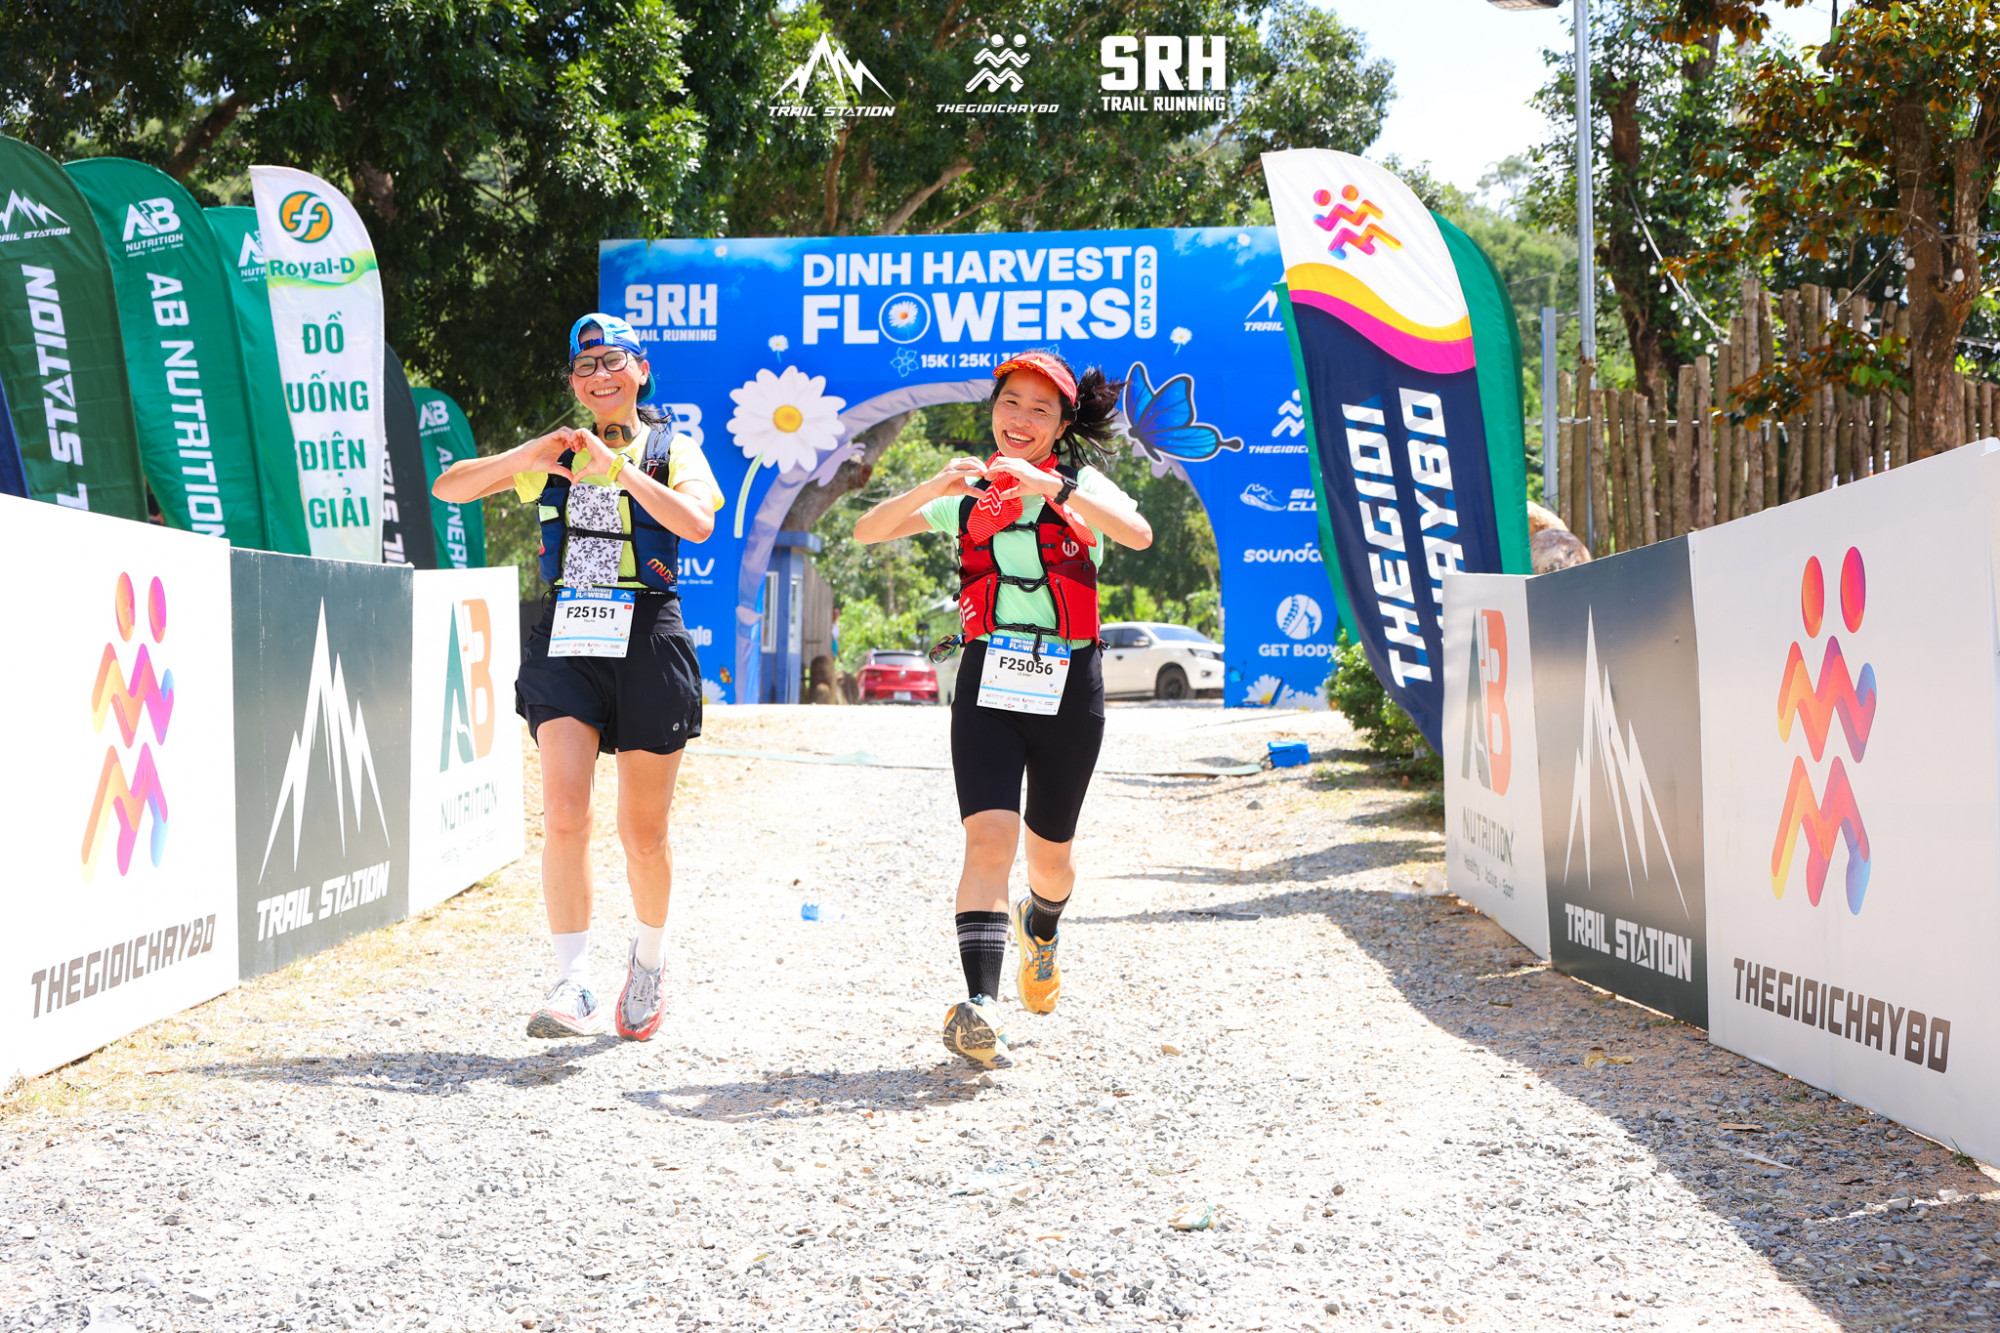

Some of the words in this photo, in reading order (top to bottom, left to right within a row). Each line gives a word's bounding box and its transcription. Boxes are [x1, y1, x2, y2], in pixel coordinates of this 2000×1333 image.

[0, 233, 20, 242] AIL
[24, 227, 71, 240] STATION
[122, 197, 181, 242] AB
[125, 233, 184, 252] NUTRITION
[269, 257, 355, 278] Royal-D
[803, 252, 912, 287] DINH
[923, 246, 1133, 285] HARVEST
[146, 272, 190, 327] AB
[625, 284, 718, 327] SRH
[1140, 254, 1152, 331] 2025
[301, 311, 345, 355] ĐỒ
[634, 329, 660, 342] RAIL
[663, 328, 717, 342] RUNNING
[803, 287, 1132, 345] FLOWERS
[1244, 321, 1284, 332] TRAIL
[21, 264, 83, 466] STATION
[921, 354, 949, 368] 15K
[959, 353, 991, 368] 25K
[286, 371, 370, 413] UỐNG
[419, 400, 449, 430] AB
[298, 431, 366, 479] ĐIỆN
[1248, 445, 1309, 454] THEGIOIC
[308, 488, 371, 529] GIẢI
[1398, 387, 1464, 645] AYBO
[1243, 543, 1326, 562] soundc
[566, 606, 616, 619] F25151
[999, 656, 1053, 676] F25056
[1258, 643, 1290, 657] GET
[440, 598, 495, 773] AB
[1462, 608, 1512, 797] AB
[440, 780, 498, 834] NUTRITION
[1462, 806, 1514, 868] NUTRITION
[257, 886, 314, 942] TRAIL
[318, 861, 391, 922] STATION
[1564, 903, 1611, 958] TRAIL
[1615, 917, 1692, 983] STATION
